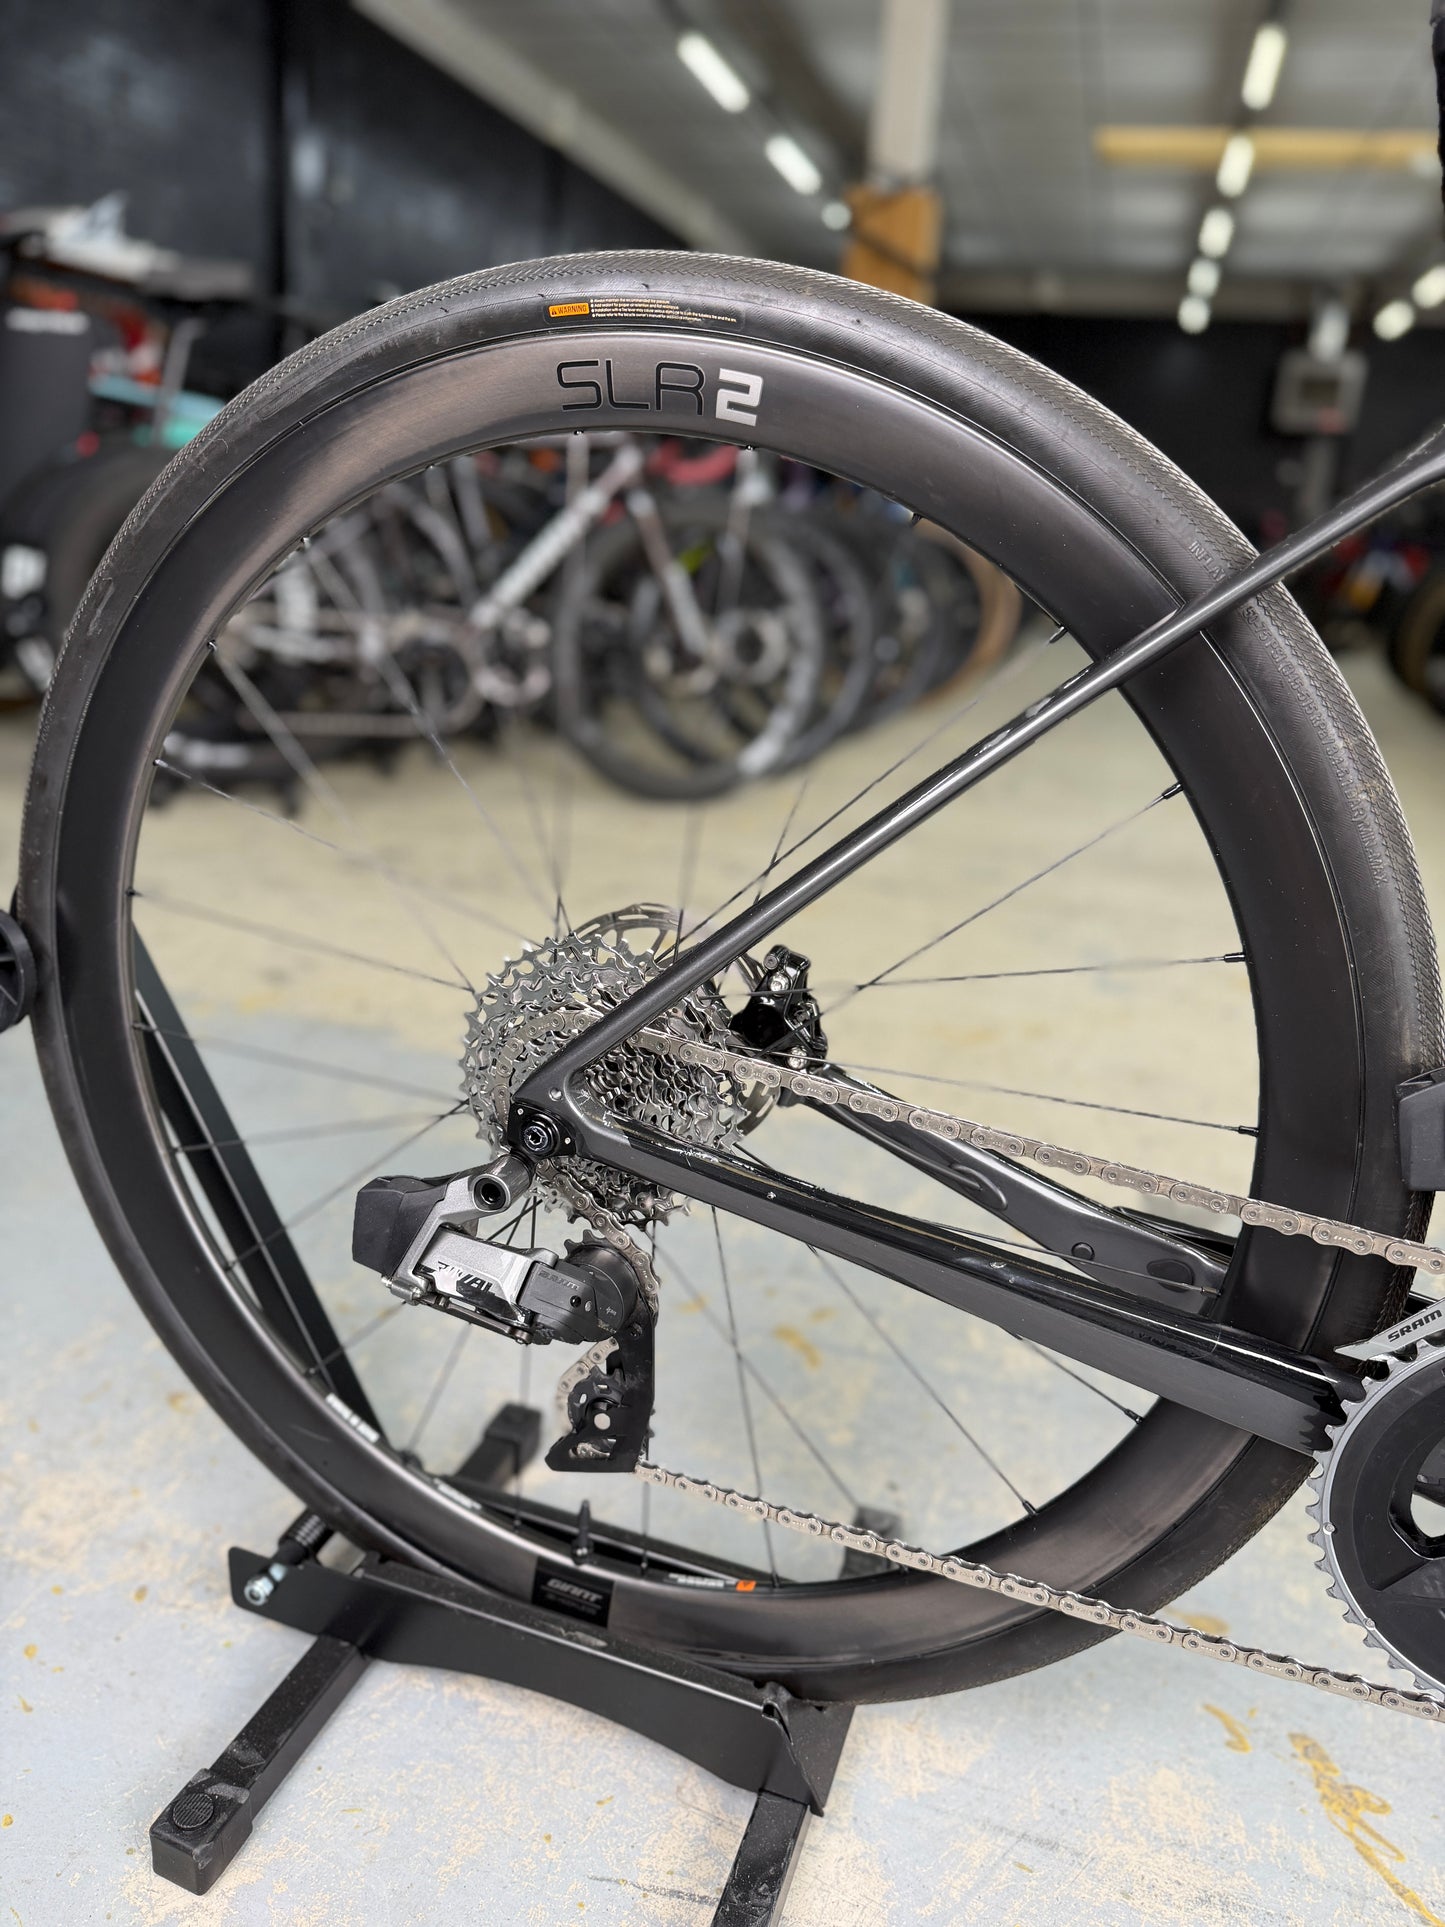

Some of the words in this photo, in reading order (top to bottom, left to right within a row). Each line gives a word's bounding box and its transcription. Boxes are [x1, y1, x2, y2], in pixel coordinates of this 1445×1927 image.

[557, 304, 587, 314] WARNING
[557, 359, 706, 416] SLR
[715, 367, 764, 427] 2
[1186, 538, 1228, 583] INFLAT
[1388, 1310, 1442, 1342] SRAM
[547, 1578, 603, 1602] GIANT
